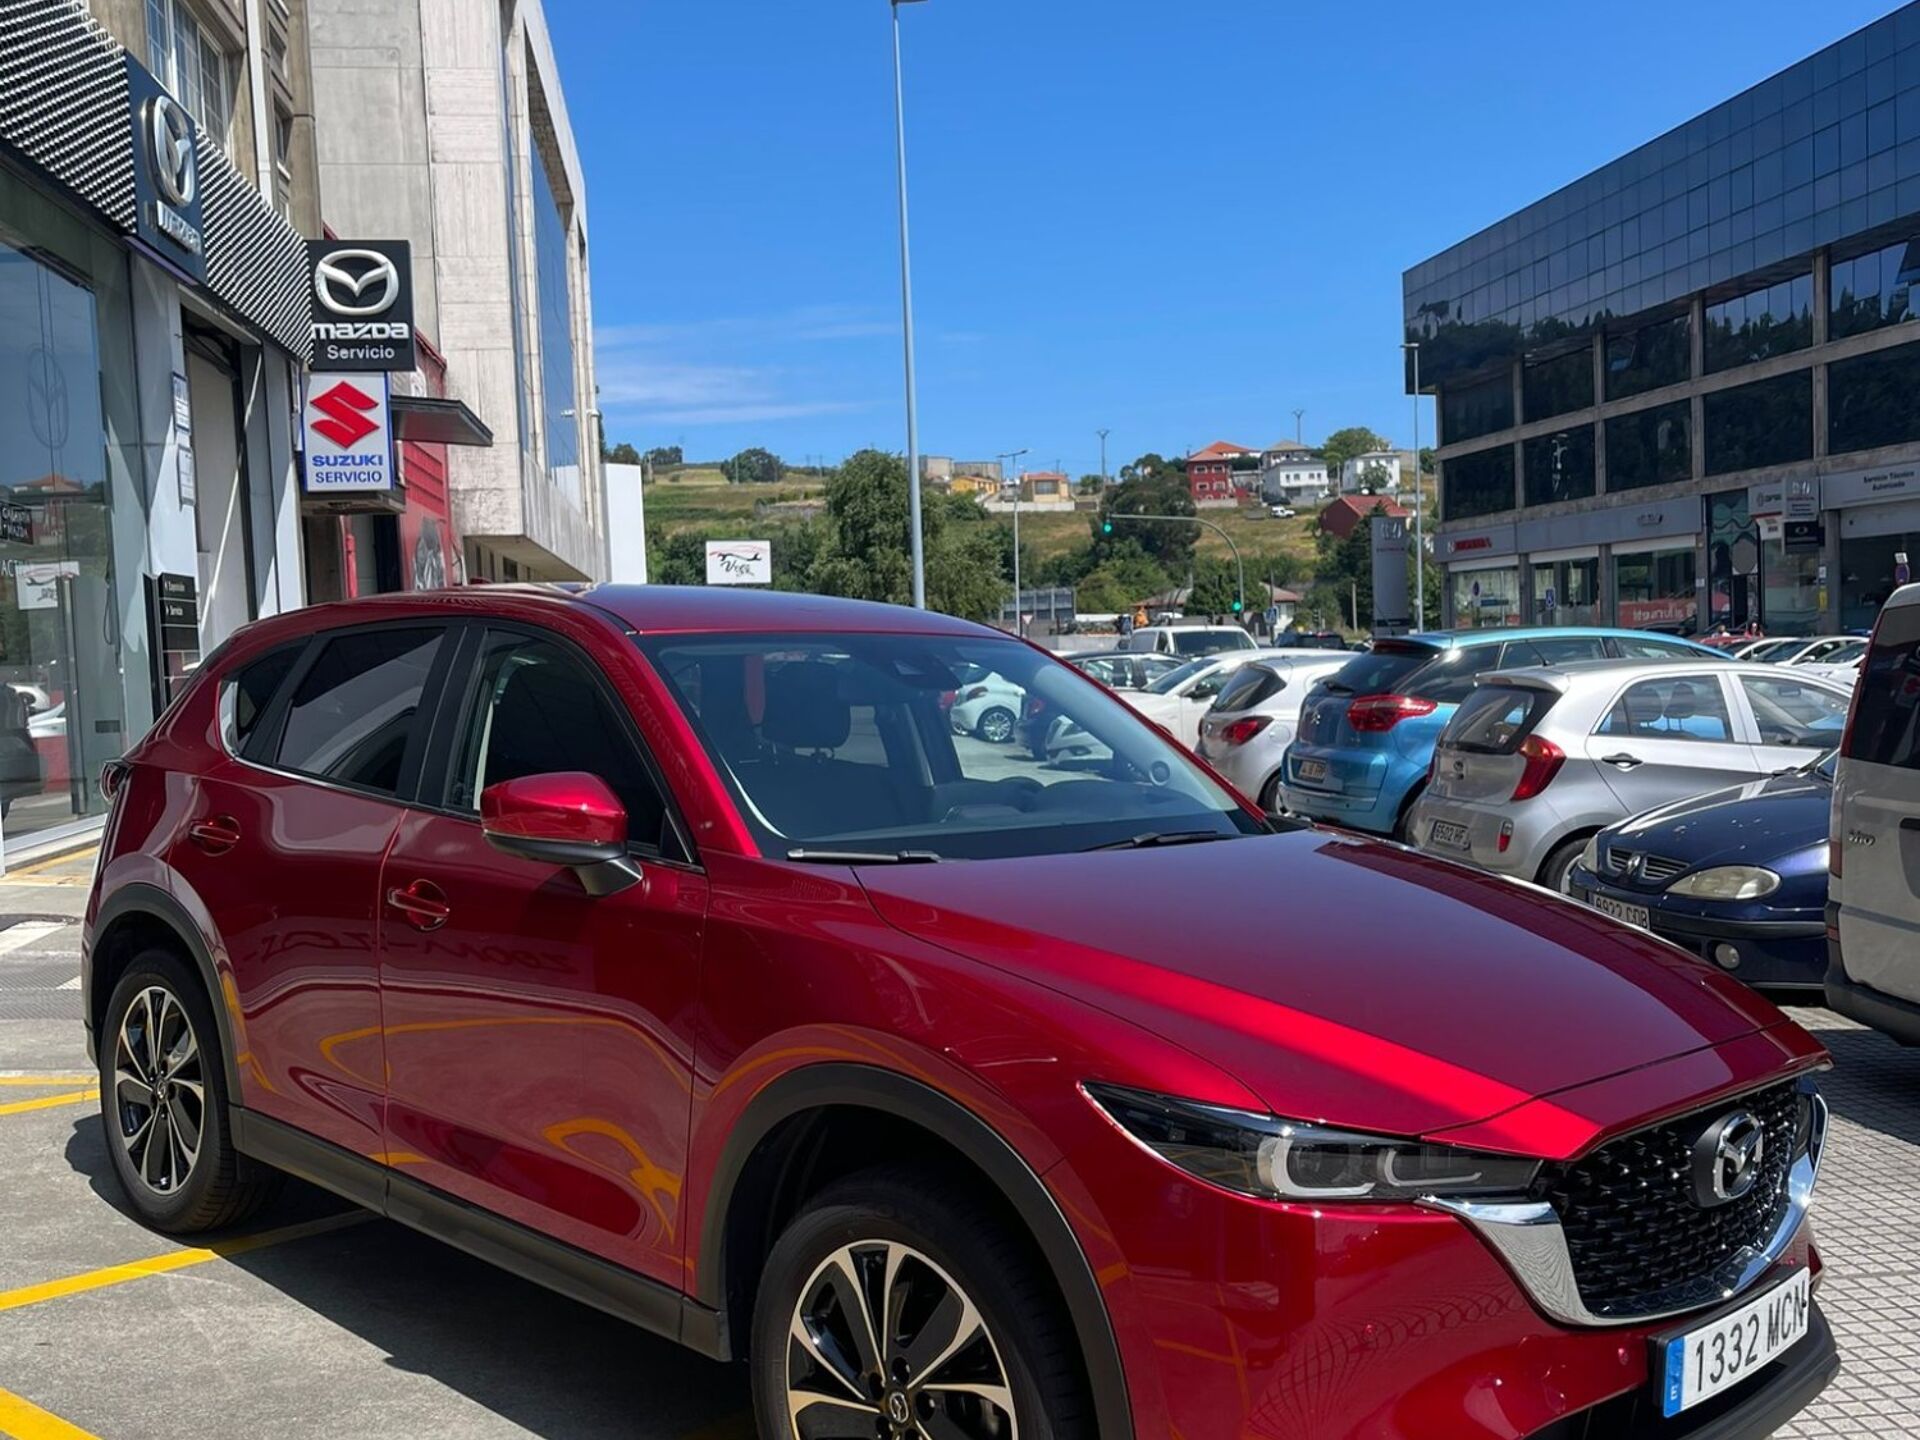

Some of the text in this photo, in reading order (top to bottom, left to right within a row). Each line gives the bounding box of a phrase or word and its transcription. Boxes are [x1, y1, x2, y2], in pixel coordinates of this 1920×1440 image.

[327, 345, 395, 359] Servicio
[312, 455, 383, 467] SUZUKI
[315, 471, 382, 483] SERVICIO
[1695, 1279, 1806, 1393] 1332 MCN
